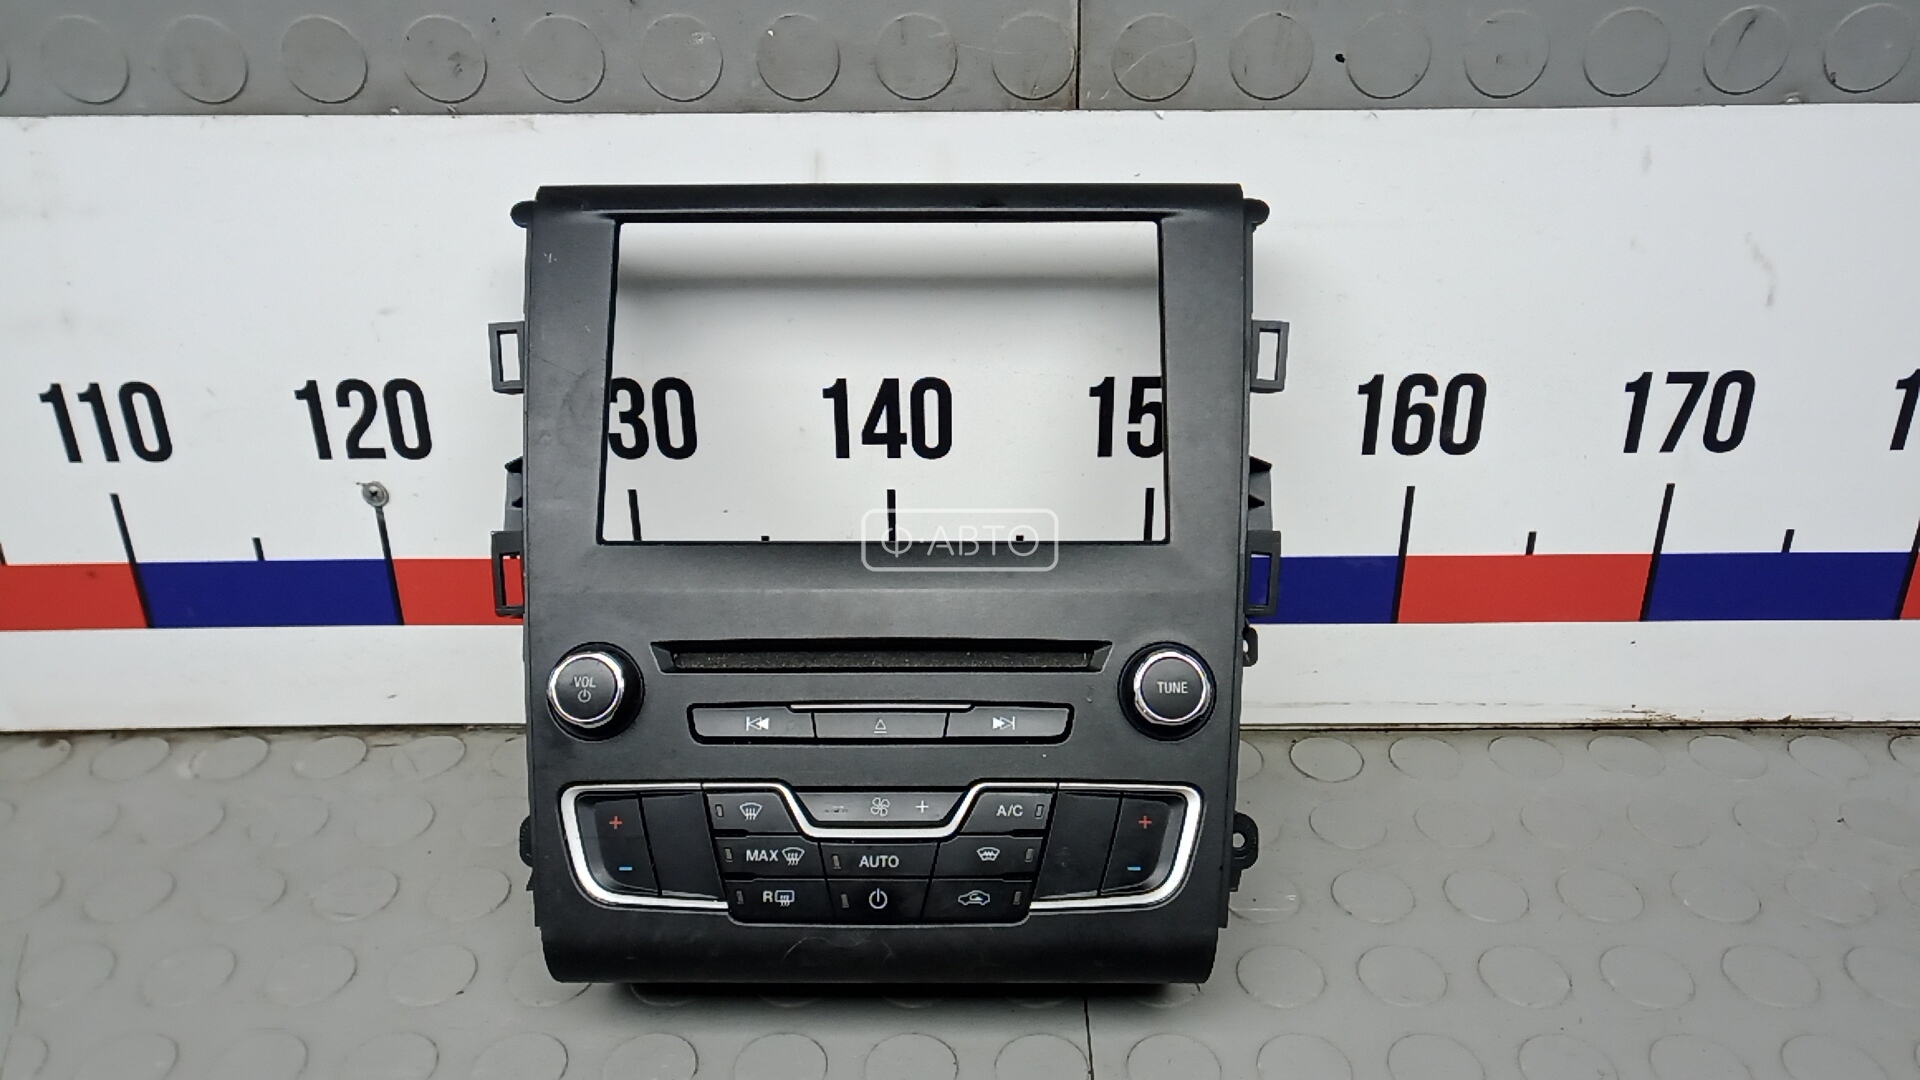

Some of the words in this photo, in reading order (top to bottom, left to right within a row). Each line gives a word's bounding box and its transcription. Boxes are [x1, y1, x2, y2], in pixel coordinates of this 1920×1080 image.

[39, 381, 173, 463] 110
[294, 379, 432, 459] 120
[607, 377, 697, 459] 30
[822, 377, 953, 459] 140
[1089, 376, 1165, 458] 15
[1357, 373, 1487, 456] 160
[1623, 369, 1756, 453] 170
[574, 676, 596, 688] VOL
[1157, 681, 1188, 694] TUNE
[996, 804, 1023, 817] A/C
[745, 849, 779, 862] MAX
[859, 855, 900, 868] AUTO
[762, 891, 773, 902] R
